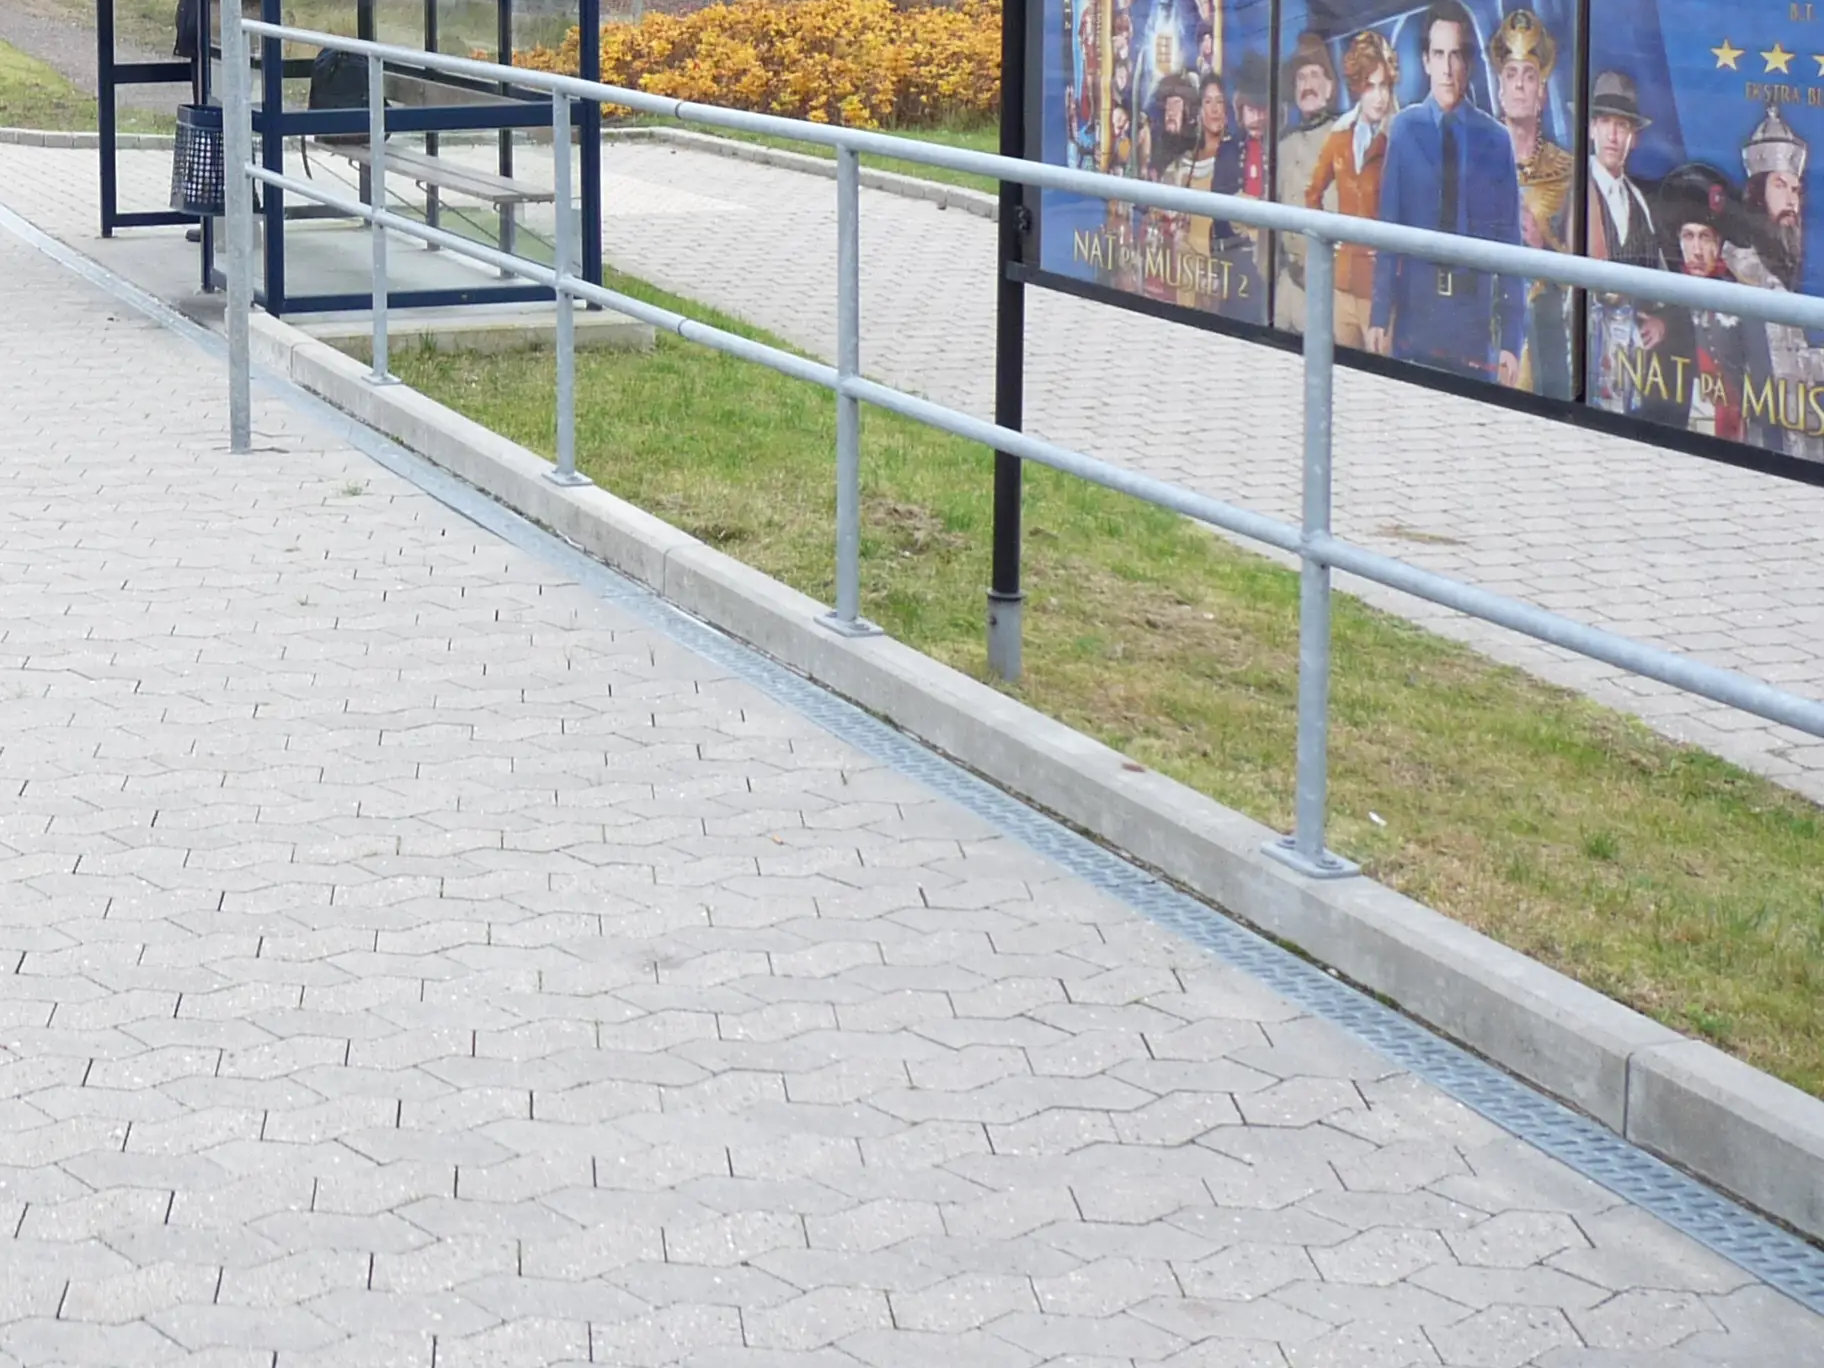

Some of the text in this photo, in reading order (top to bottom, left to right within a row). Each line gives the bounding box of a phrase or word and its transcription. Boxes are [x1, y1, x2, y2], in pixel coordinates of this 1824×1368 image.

[1745, 81, 1801, 104] EKSTRA
[1073, 229, 1117, 270] NAT
[1144, 246, 1233, 300] MUSEET
[1238, 274, 1250, 299] 2
[1616, 348, 1691, 404] NAT
